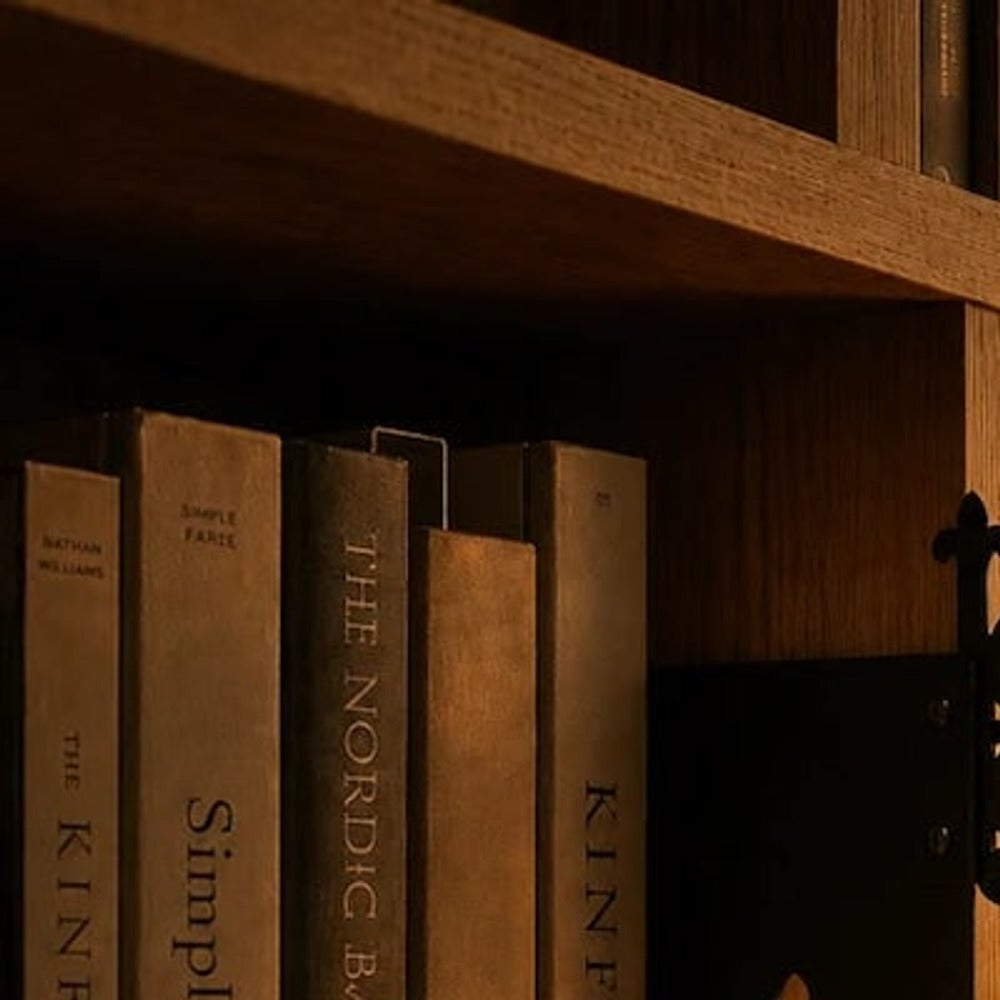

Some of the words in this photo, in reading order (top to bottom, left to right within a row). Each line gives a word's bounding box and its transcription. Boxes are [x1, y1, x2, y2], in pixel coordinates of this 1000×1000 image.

[38, 559, 104, 579] WILLIAMS
[342, 529, 380, 646] THE
[62, 731, 82, 791] THE
[342, 673, 379, 920] NORDIC
